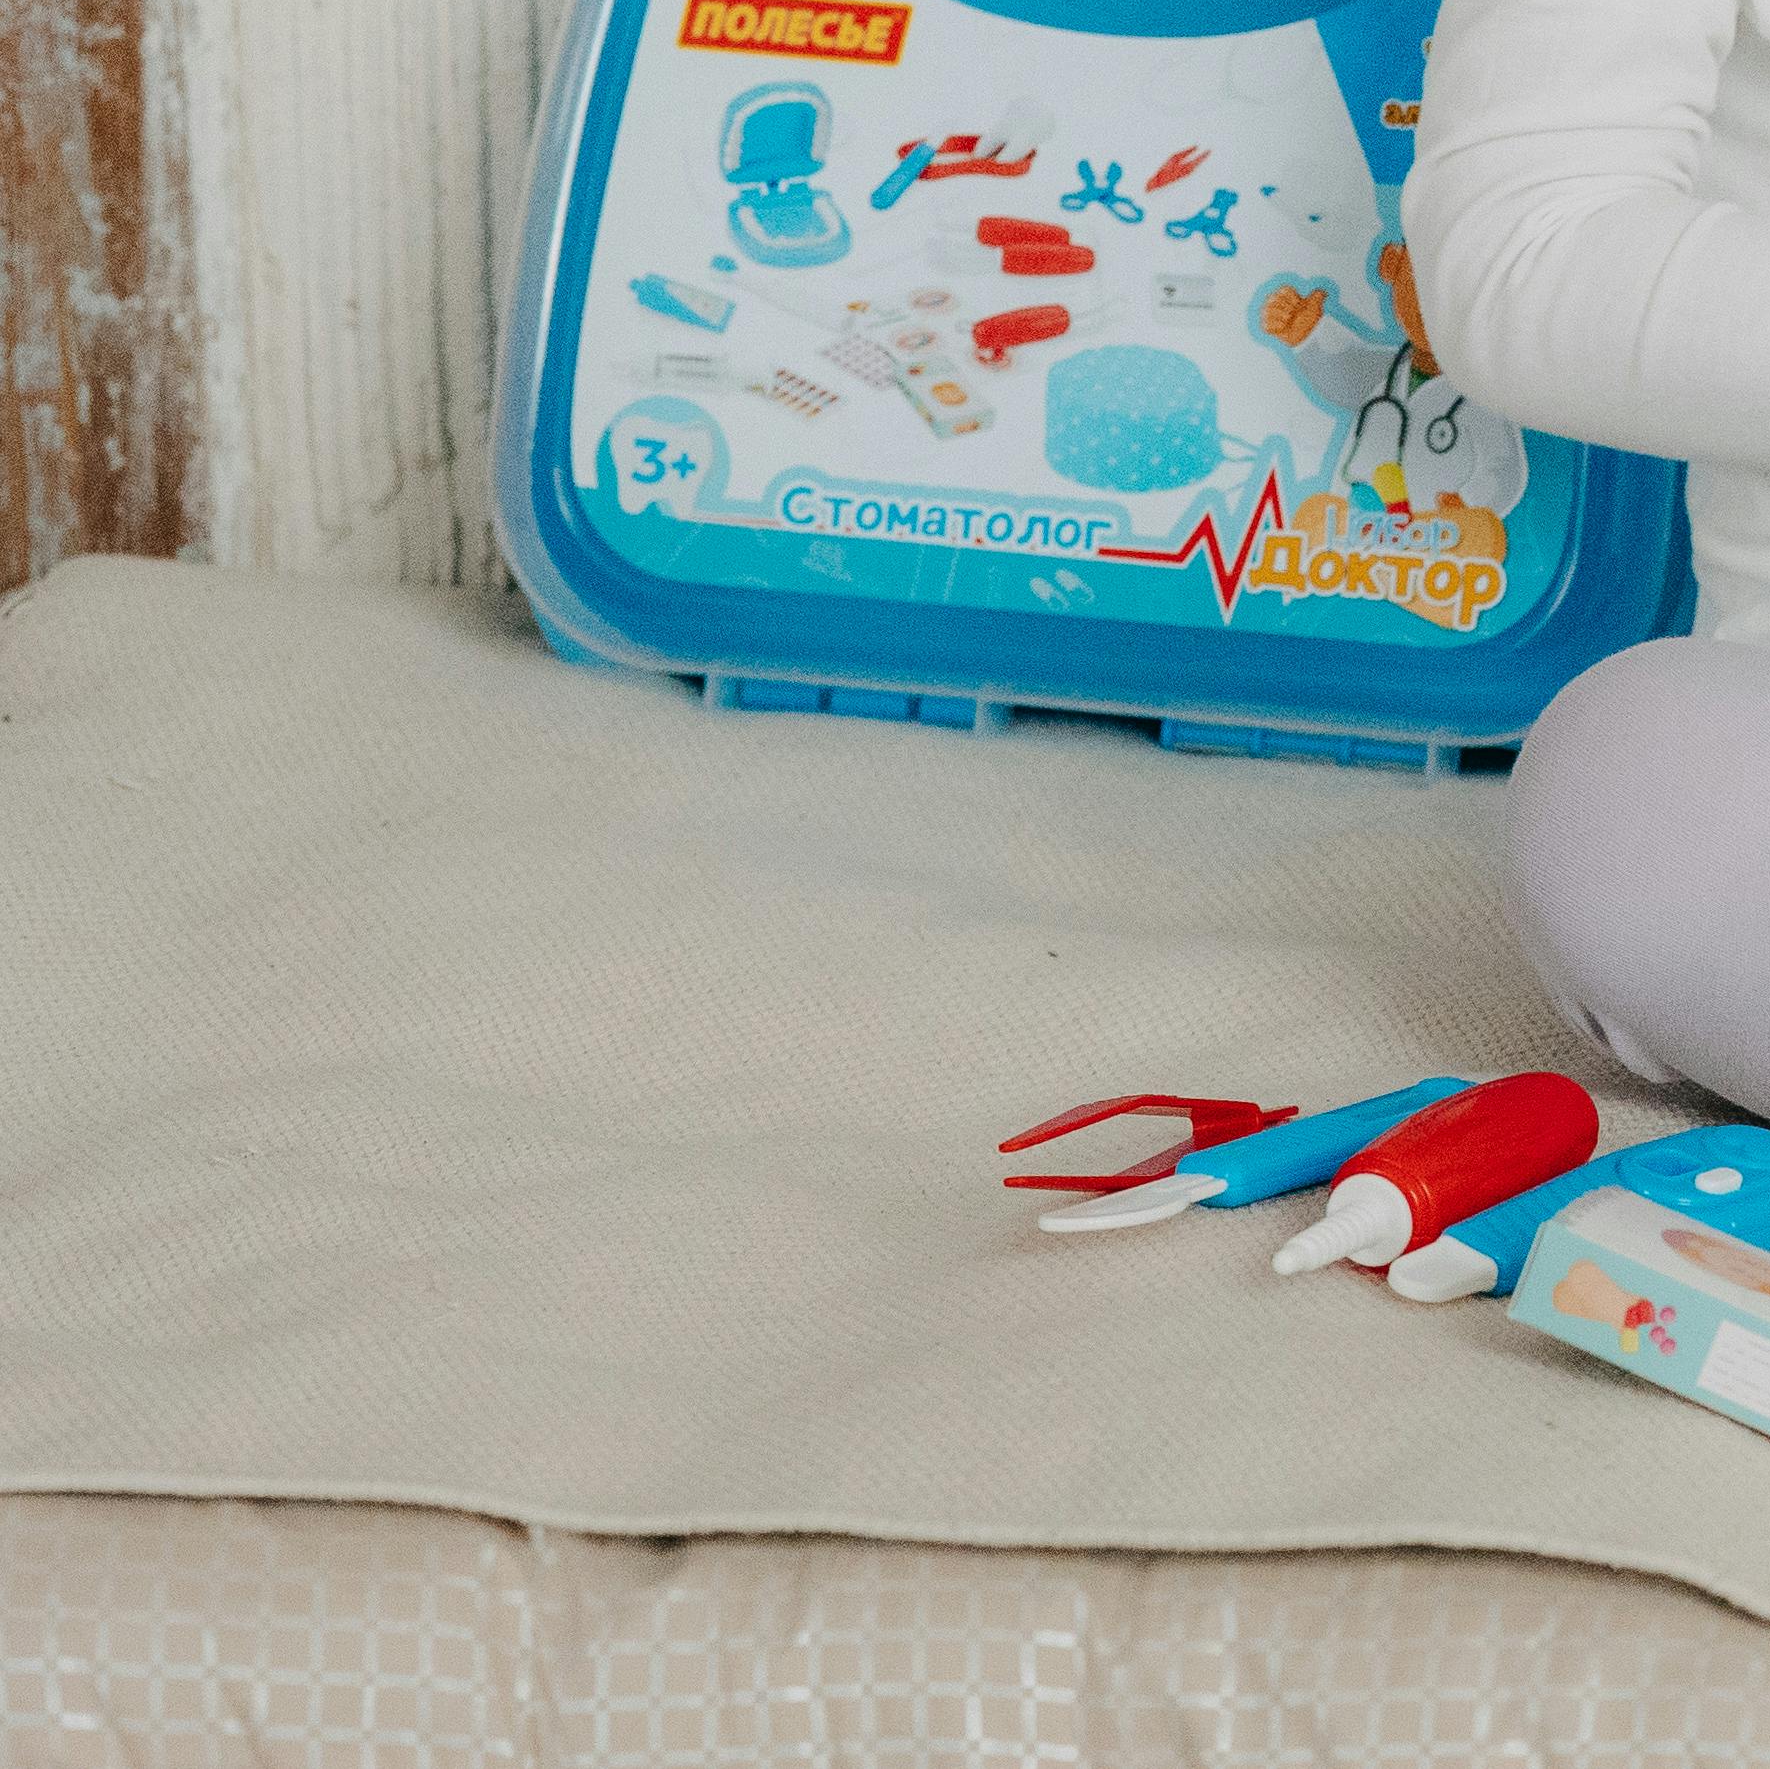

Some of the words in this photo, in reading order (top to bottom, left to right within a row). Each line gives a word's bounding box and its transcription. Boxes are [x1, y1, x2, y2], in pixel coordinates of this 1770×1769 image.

[692, 1, 893, 54] ПОЛЕСЬЕ
[631, 438, 696, 484] 3+
[782, 486, 1112, 550] Стоматолог
[1249, 534, 1501, 626] Доктор
